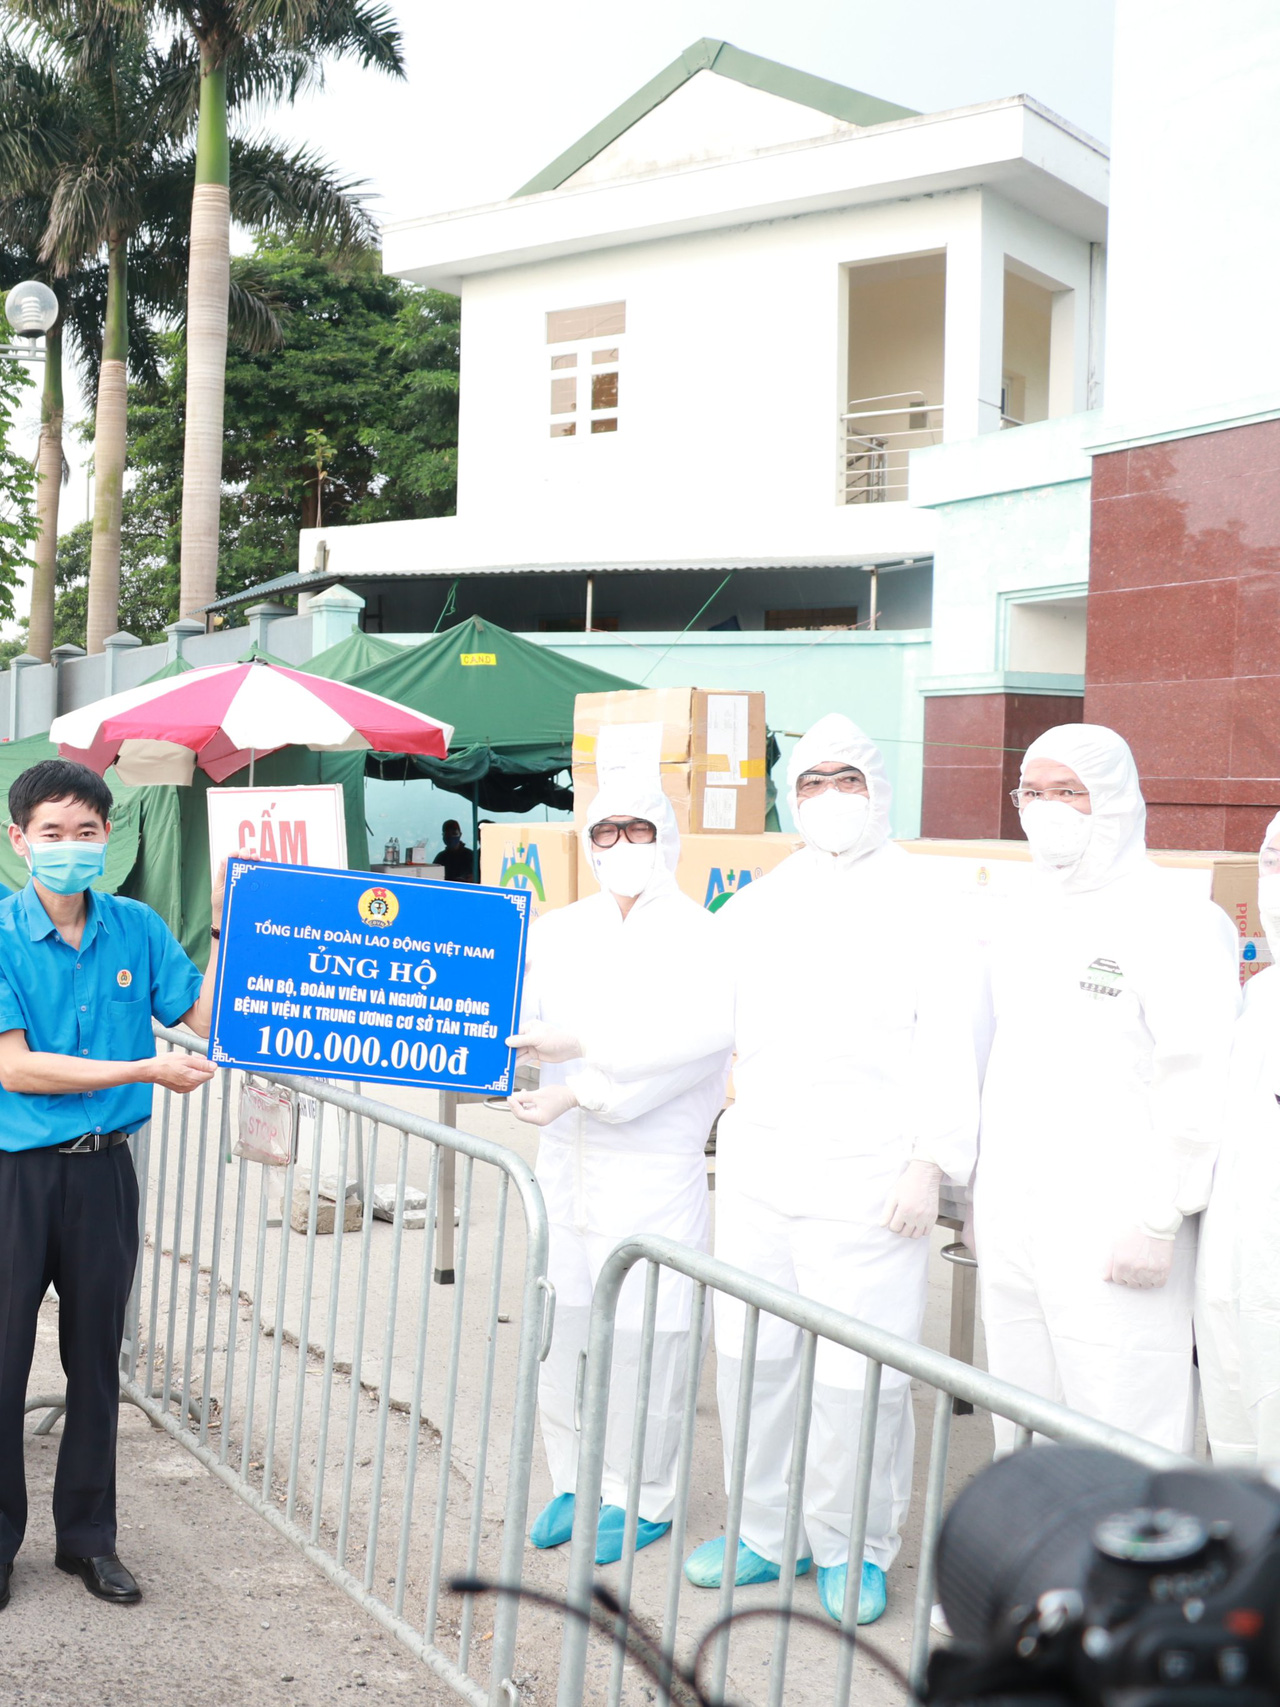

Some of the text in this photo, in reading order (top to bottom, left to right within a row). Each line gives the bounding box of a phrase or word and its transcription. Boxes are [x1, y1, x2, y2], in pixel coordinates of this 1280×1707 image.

[238, 802, 308, 866] CẤM
[254, 919, 495, 959] TỔNG LIÊN ĐOÀN LAO ĐỘNG VIỆT NAM
[308, 945, 437, 990] ỦNG HỘ
[234, 996, 269, 1015] BỆNH
[271, 1000, 300, 1020] VIỆN
[302, 1005, 312, 1019] K
[315, 1006, 356, 1024] TRUNG
[358, 1010, 393, 1028] ƯƠNG
[395, 1015, 414, 1030] CƠ
[415, 1014, 434, 1032] SỞ
[436, 1018, 460, 1035] TÂN
[247, 975, 490, 1017] CÁN BỘ, ĐOÀN VIÊN VÀ NGƯỜI LAO ĐỘNG
[256, 1025, 470, 1075] 100.000.000đ
